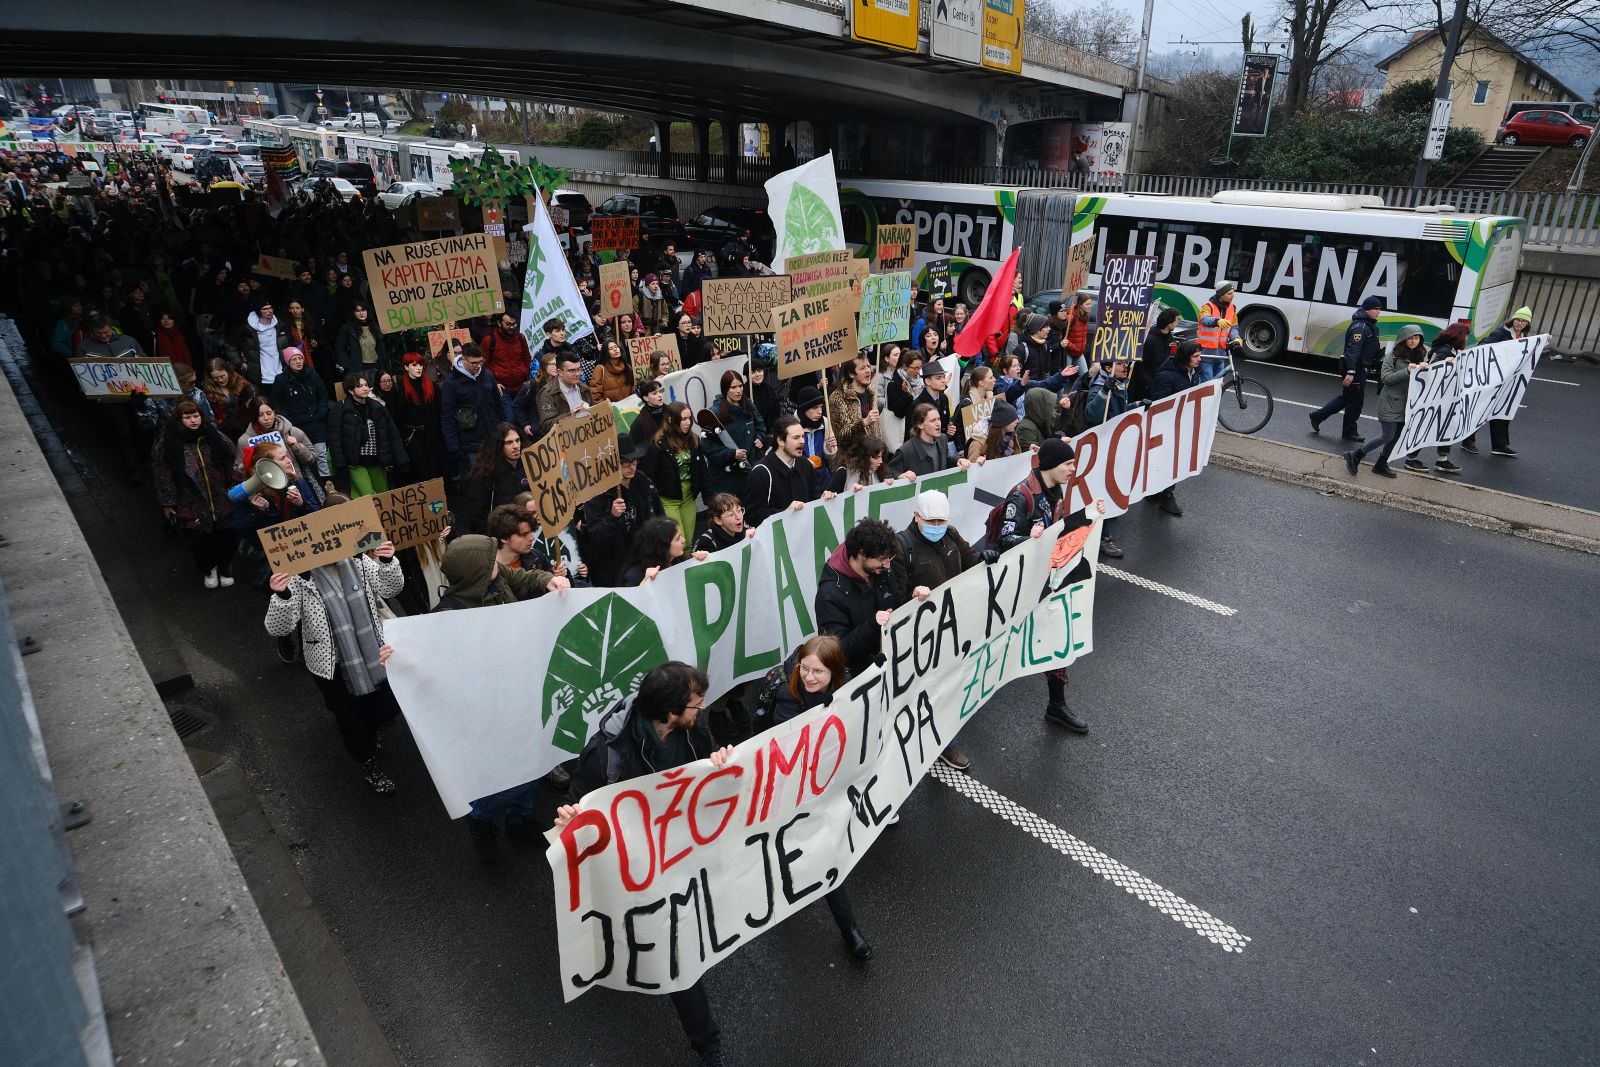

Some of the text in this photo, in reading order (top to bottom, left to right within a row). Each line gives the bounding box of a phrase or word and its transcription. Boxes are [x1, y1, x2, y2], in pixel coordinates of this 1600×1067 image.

[952, 8, 969, 23] Center
[879, 227, 912, 245] NARAVO
[895, 198, 997, 259] ŠPORT
[374, 249, 396, 267] NA
[404, 236, 487, 261] RUŠEVINAH
[832, 251, 849, 263] BREZ
[880, 257, 905, 270] PROFIT
[901, 244, 910, 258] NI
[381, 255, 488, 289] KAPITALIZMA
[840, 266, 848, 275] JE
[1094, 226, 1399, 311] LJUBLJANA
[1105, 257, 1157, 287] OBLJUBE
[389, 275, 489, 305] BOMO ZGRADILI
[707, 290, 789, 305] NE POTREBUJE
[708, 279, 788, 294] NARAVA NAS
[1104, 286, 1149, 308] RAZNE,
[454, 289, 497, 317] SVET
[703, 300, 791, 317] MI POTREBUJE
[779, 298, 830, 328] ZA RIBE
[1103, 306, 1145, 326] ŠE VEDNO
[707, 313, 774, 333] NARAV
[782, 315, 831, 346] ZA PTICE
[871, 321, 898, 342] GOZD
[630, 336, 658, 355] SMRT
[713, 337, 741, 350] SMRDI
[784, 339, 843, 365] ZA PRAVICE
[803, 327, 849, 351] DELAVSKE
[1092, 325, 1146, 362] PRAZNE
[72, 363, 118, 388] RIGHTS
[124, 363, 181, 392] NATURE
[1409, 346, 1504, 410] STRAEGIJA
[523, 430, 559, 483] DOST
[1062, 385, 1216, 514] ROFIT
[391, 483, 427, 507] NAŠ
[537, 477, 567, 527] ČAS
[380, 501, 427, 528] ANET
[263, 520, 309, 543] Titanik
[292, 533, 313, 547] imel
[286, 552, 306, 563] letu
[310, 536, 342, 555] 2023
[559, 554, 1025, 912] POŽGIMO TEGA, KI
[571, 812, 839, 990] JEMLJE,
[893, 689, 942, 786] PA
[959, 584, 1085, 720] ZEMLJE
